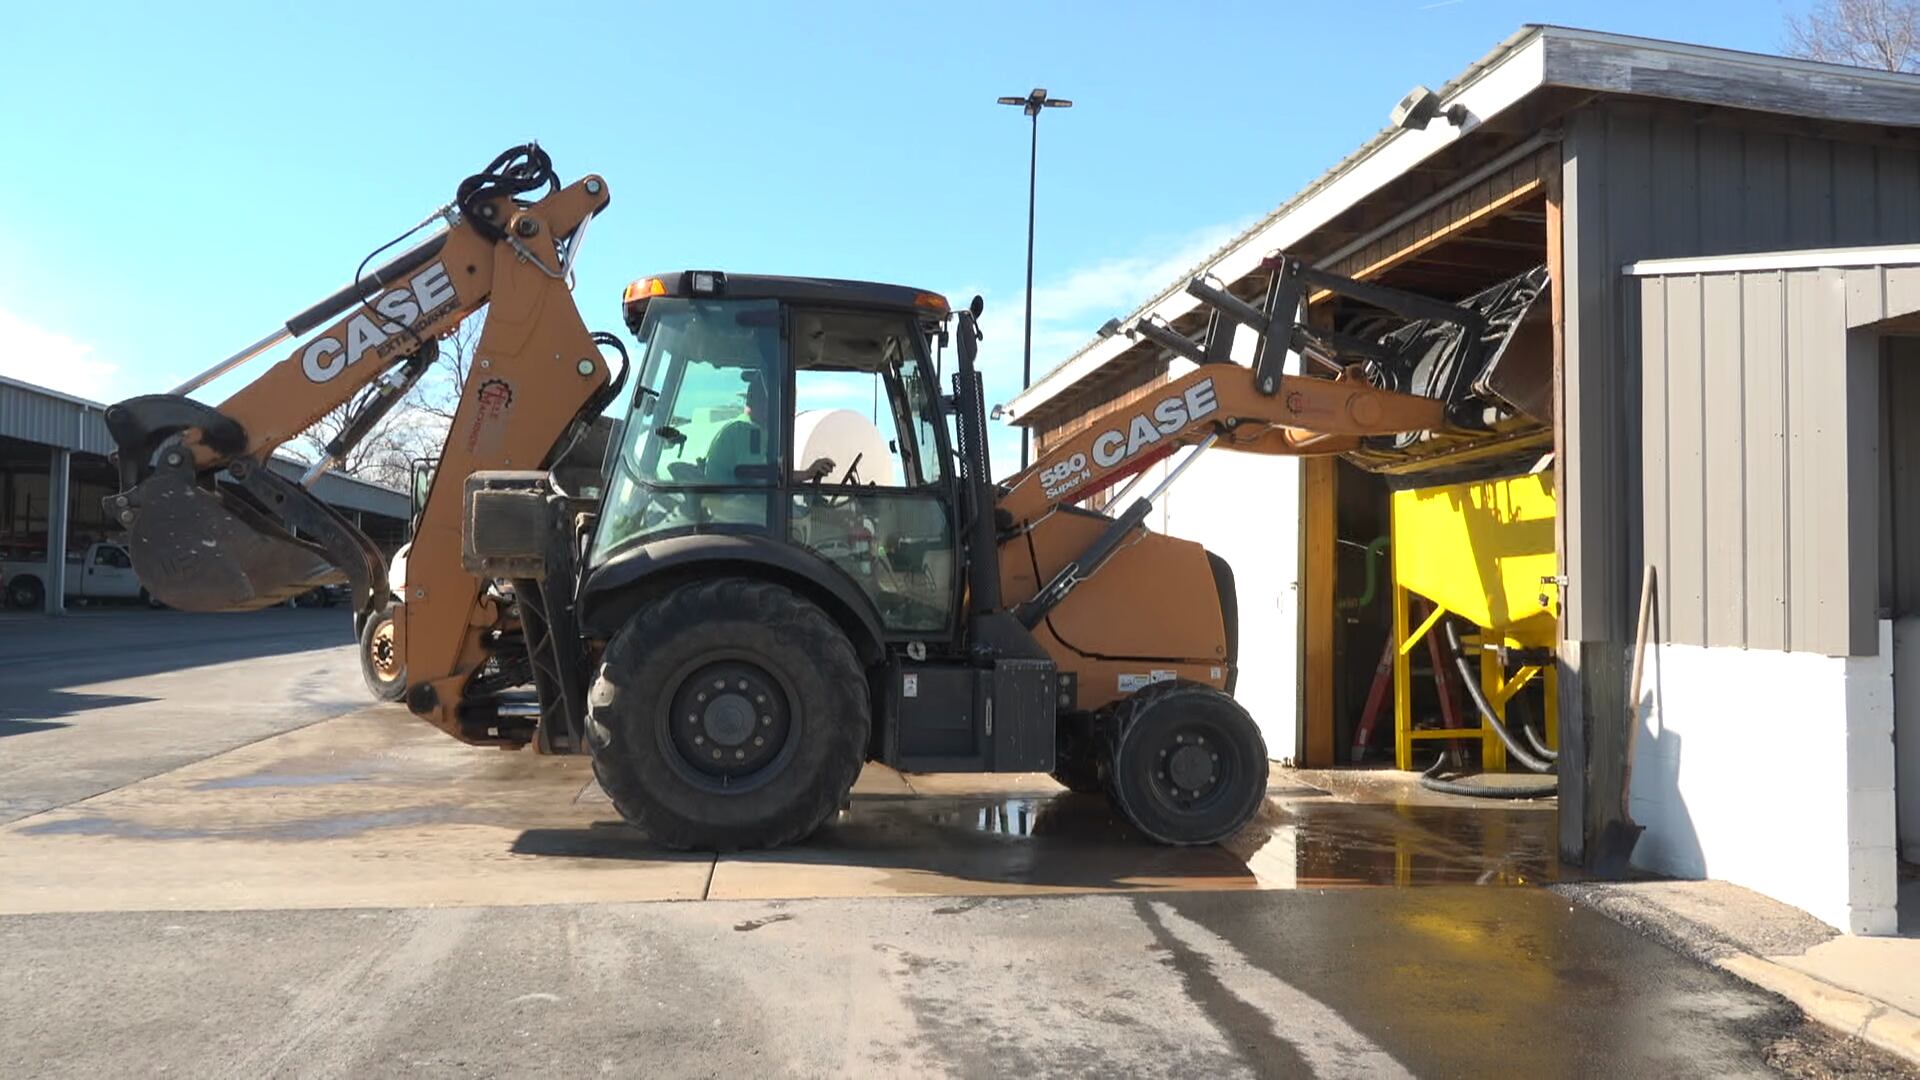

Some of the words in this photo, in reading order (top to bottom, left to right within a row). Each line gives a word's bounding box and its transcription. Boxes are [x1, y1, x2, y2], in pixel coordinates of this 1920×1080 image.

[302, 260, 456, 383] CASE
[1092, 378, 1218, 467] CASE
[1039, 452, 1087, 488] 580
[1046, 475, 1080, 499] Super
